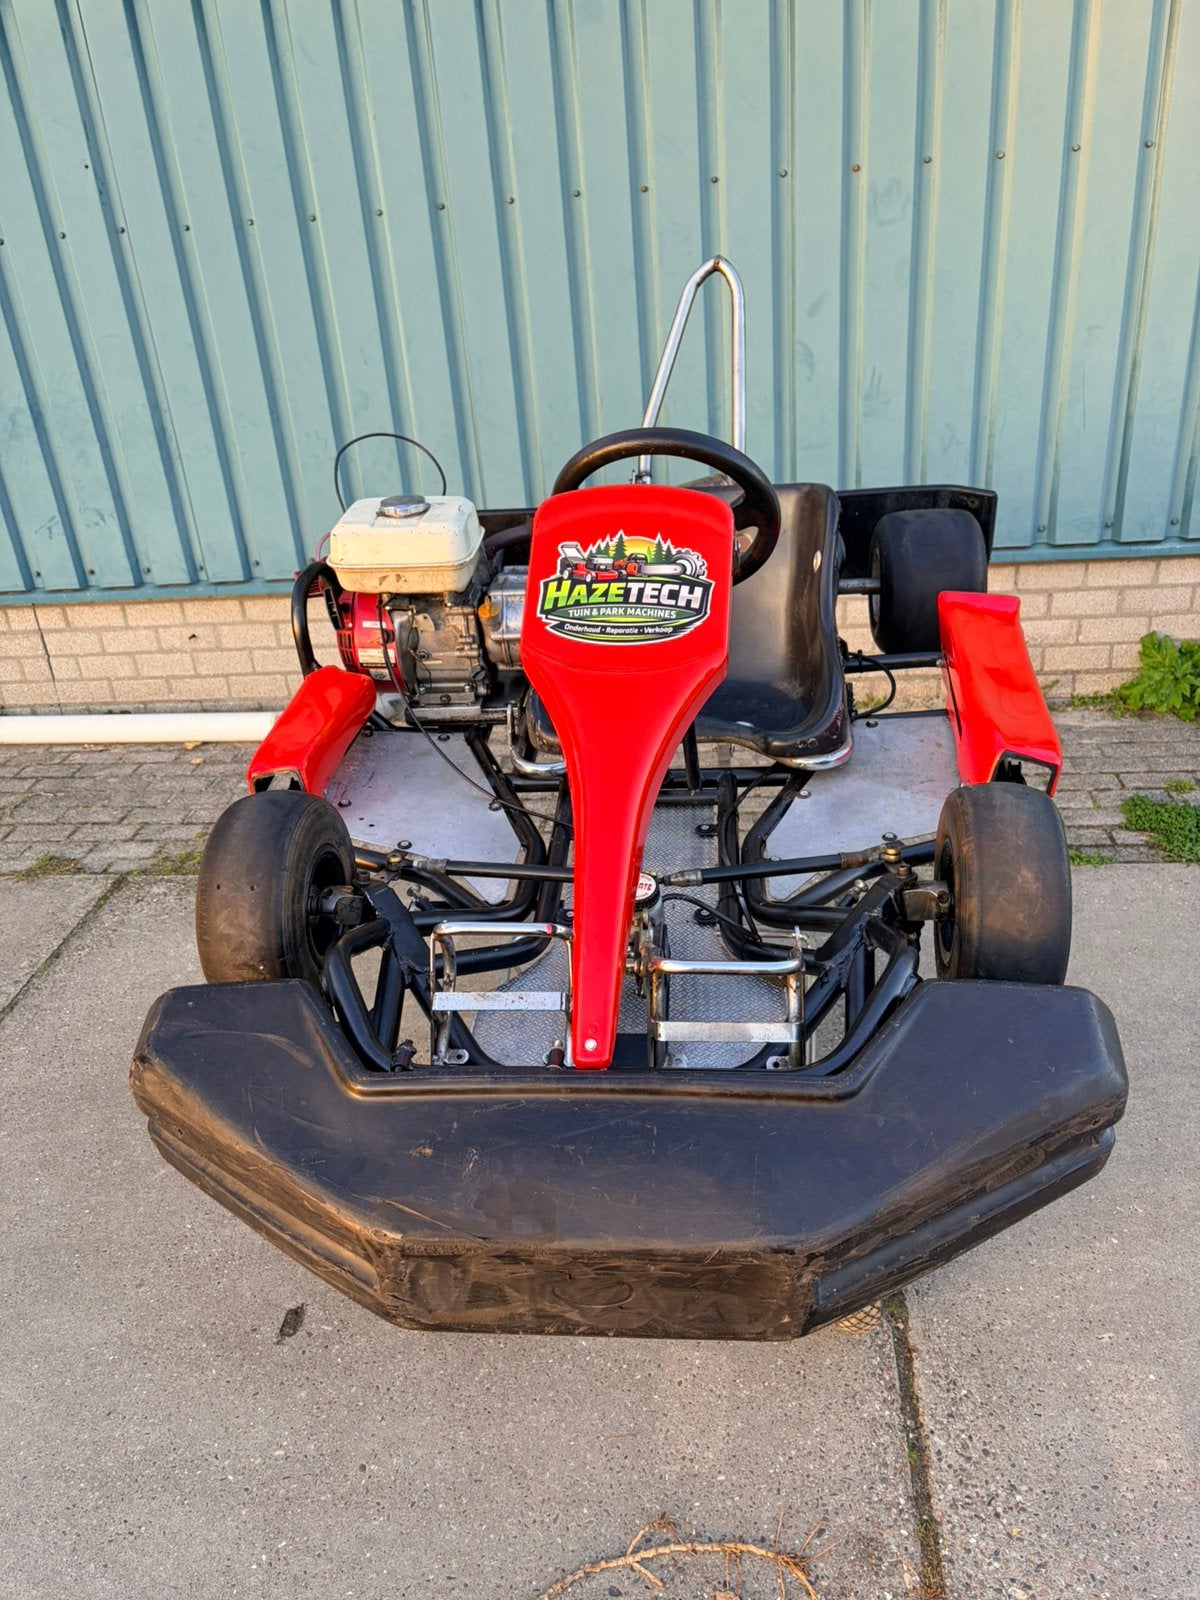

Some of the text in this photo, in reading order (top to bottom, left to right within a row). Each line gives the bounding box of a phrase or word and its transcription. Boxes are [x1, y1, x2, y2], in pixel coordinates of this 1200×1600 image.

[543, 580, 704, 610] HAZETECH
[568, 609, 590, 618] TUIN
[600, 608, 625, 616] PARK
[627, 608, 676, 619] MACHINES
[564, 623, 673, 635] Onderhoud Reparatie Verkoop
